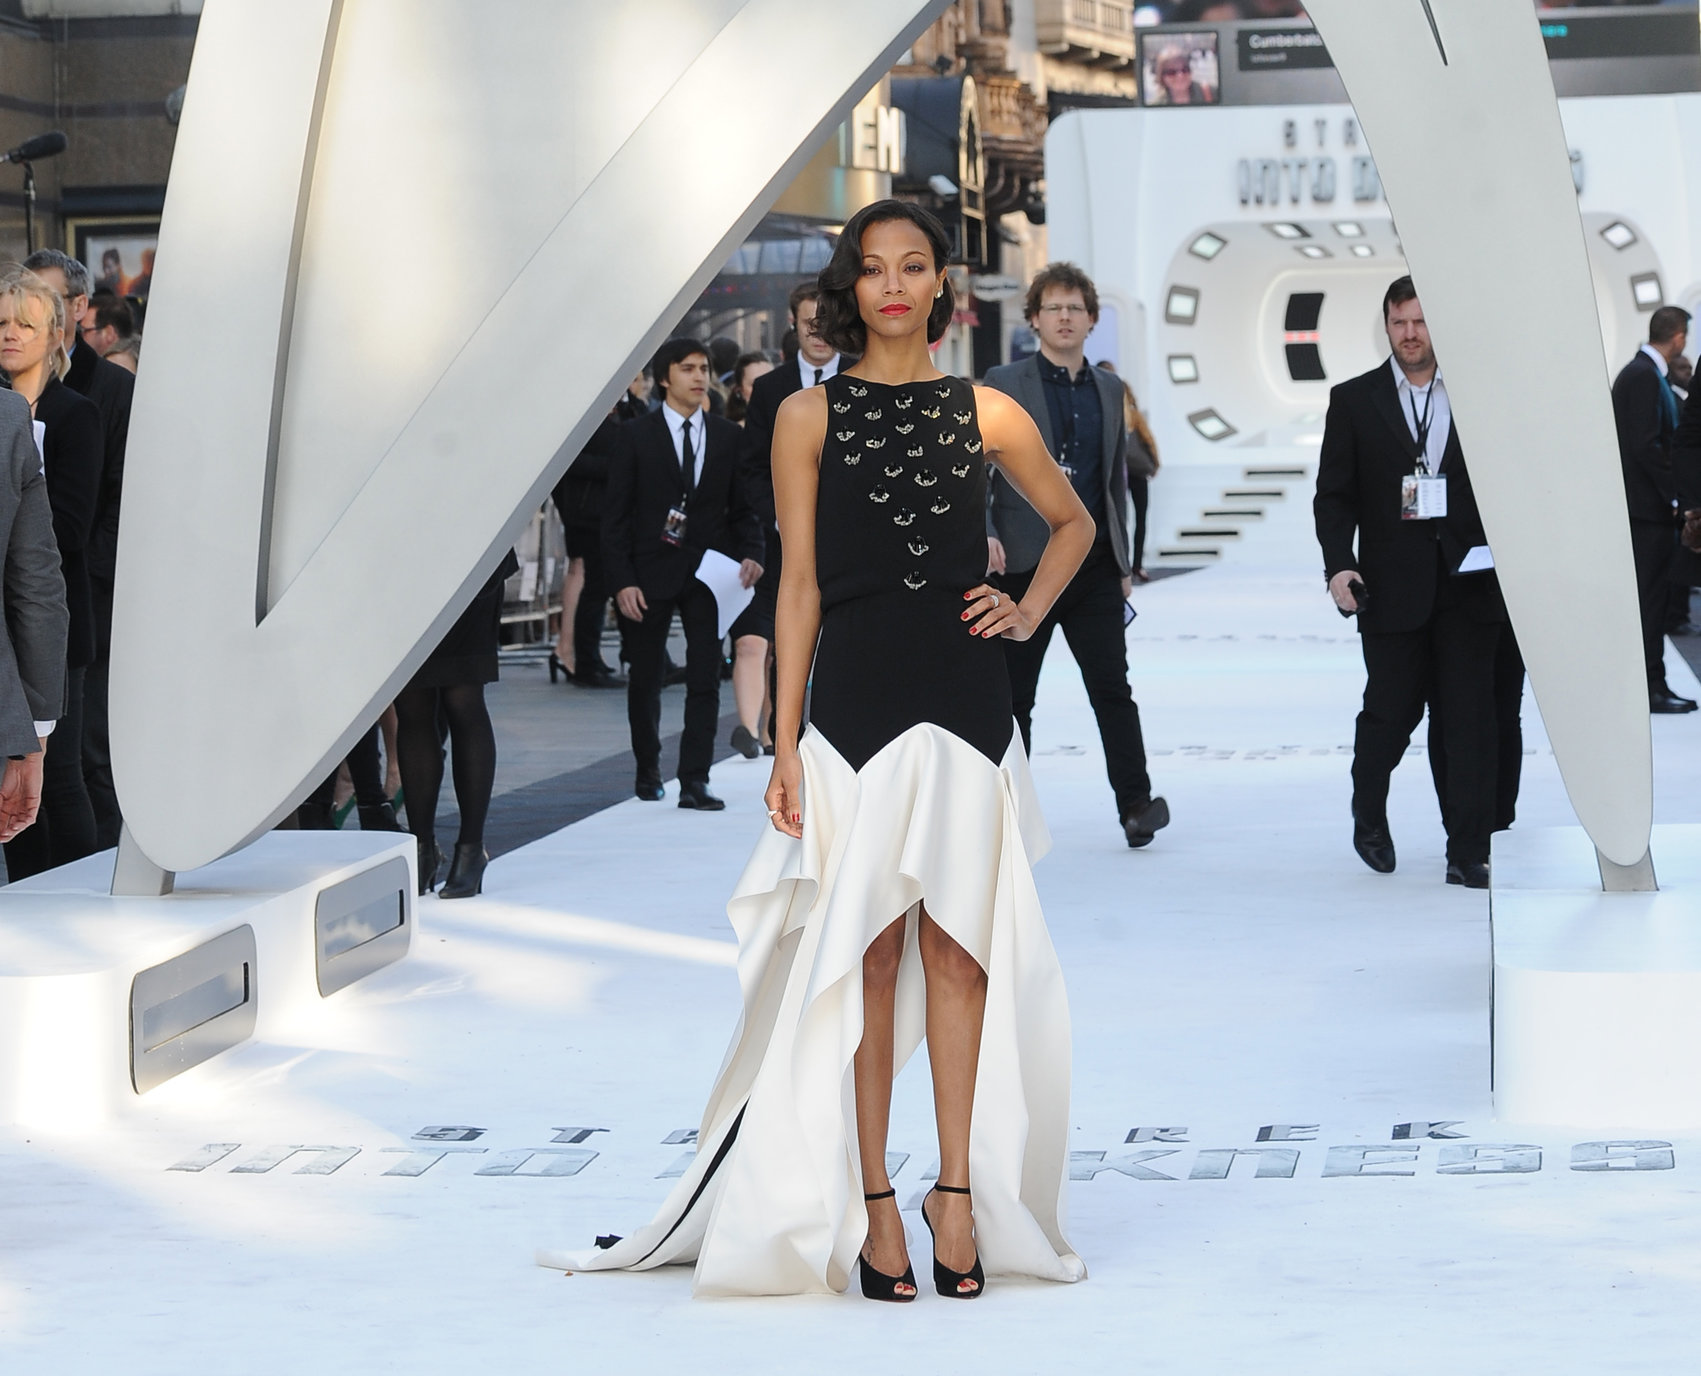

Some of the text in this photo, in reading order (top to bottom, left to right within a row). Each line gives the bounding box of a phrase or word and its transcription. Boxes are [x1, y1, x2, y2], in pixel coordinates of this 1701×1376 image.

[1237, 156, 1337, 206] INTO
[1123, 1120, 1471, 1144] REK
[164, 1142, 601, 1177] INTO
